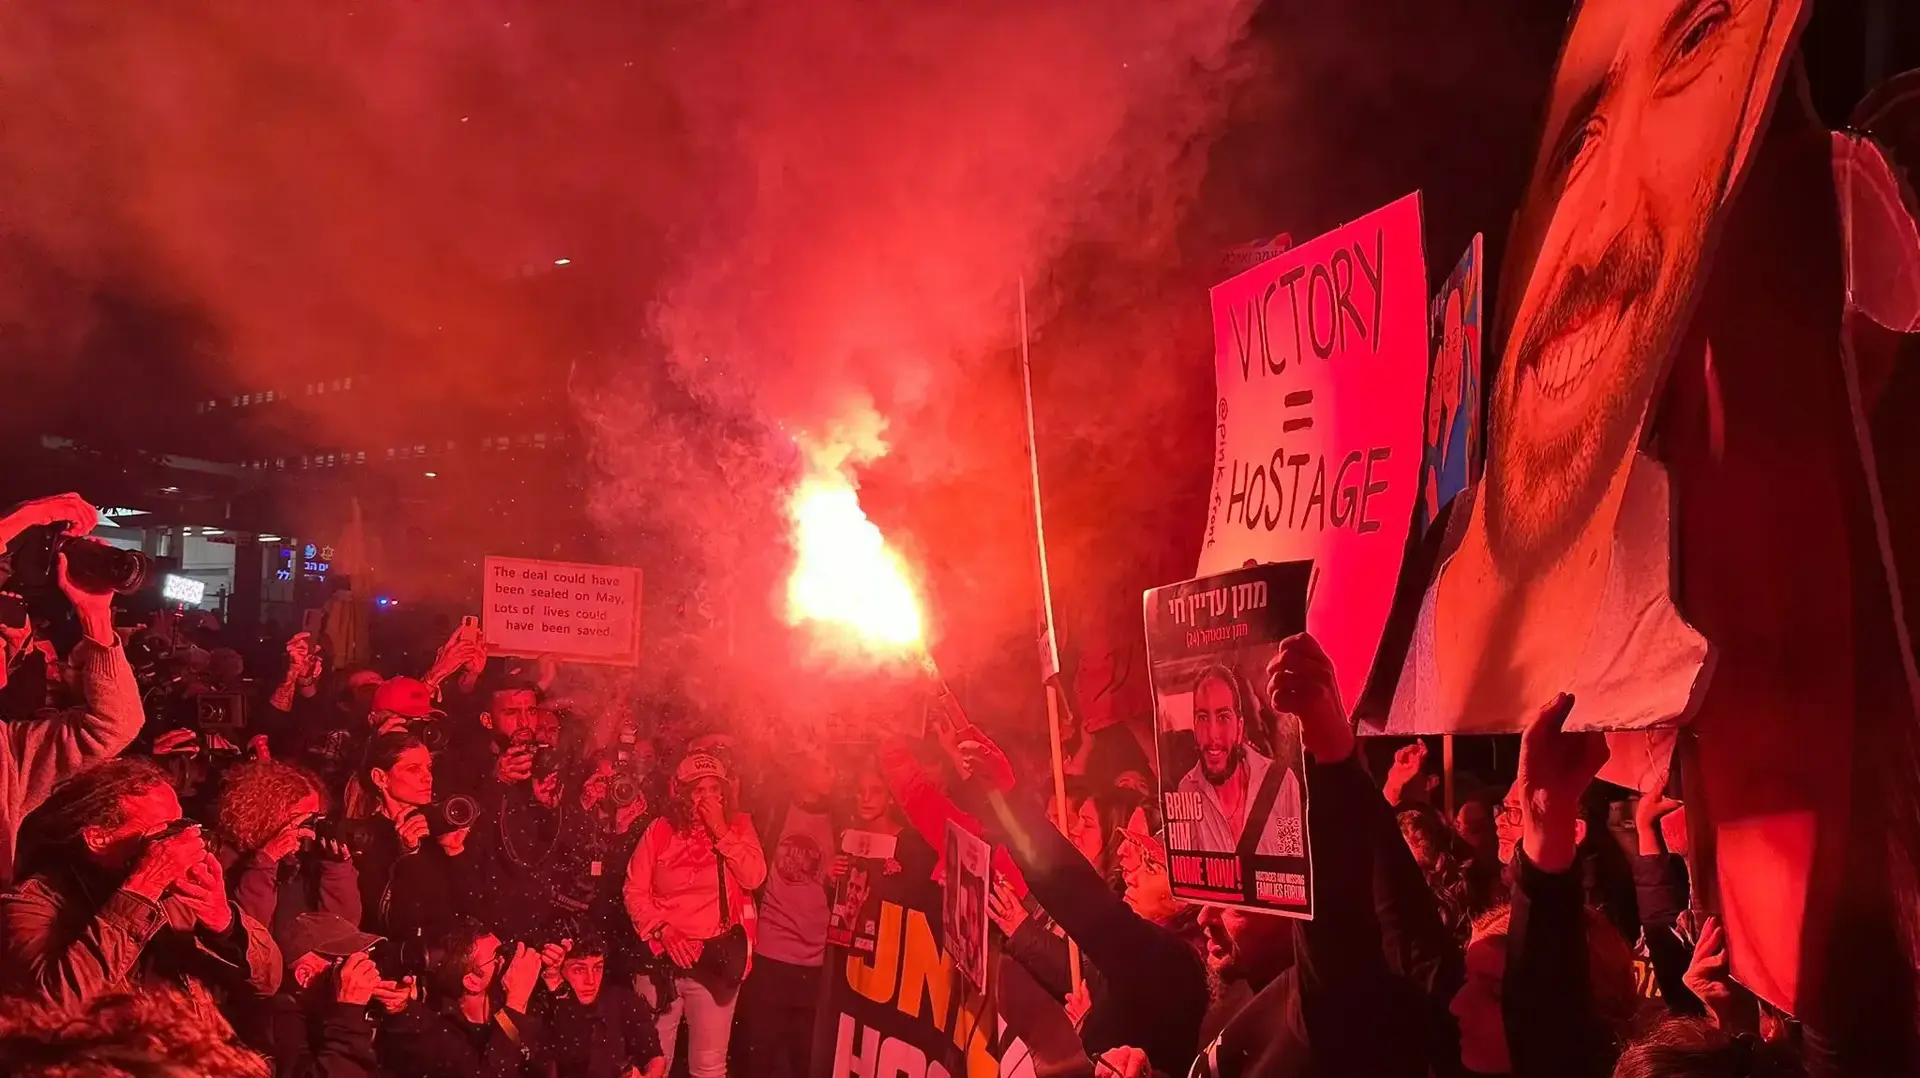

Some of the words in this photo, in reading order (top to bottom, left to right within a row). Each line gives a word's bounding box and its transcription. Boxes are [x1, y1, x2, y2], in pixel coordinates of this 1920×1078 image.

[1229, 228, 1383, 382] VICTORY
[1283, 390, 1313, 433] =
[1226, 446, 1391, 535] HOSTAGE
[494, 566, 516, 578] The
[523, 569, 548, 581] deal
[554, 573, 586, 585] could
[592, 574, 619, 586] have
[495, 583, 524, 595] been
[531, 588, 569, 599] sealed
[575, 593, 590, 601] on
[1231, 581, 1267, 618] מתן
[494, 603, 518, 614] Lots
[523, 605, 535, 615] of
[544, 606, 570, 618] lives
[576, 609, 607, 620] could
[1168, 598, 1186, 625] חי
[1188, 587, 1228, 627] עדיין
[506, 620, 534, 631] have
[542, 622, 570, 634] been
[577, 626, 613, 637] saved.
[1232, 623, 1248, 640] מתן
[1164, 792, 1203, 820] BRING
[1168, 822, 1192, 851] HIM
[1171, 855, 1205, 885] HOME
[1205, 855, 1243, 890] NOW!
